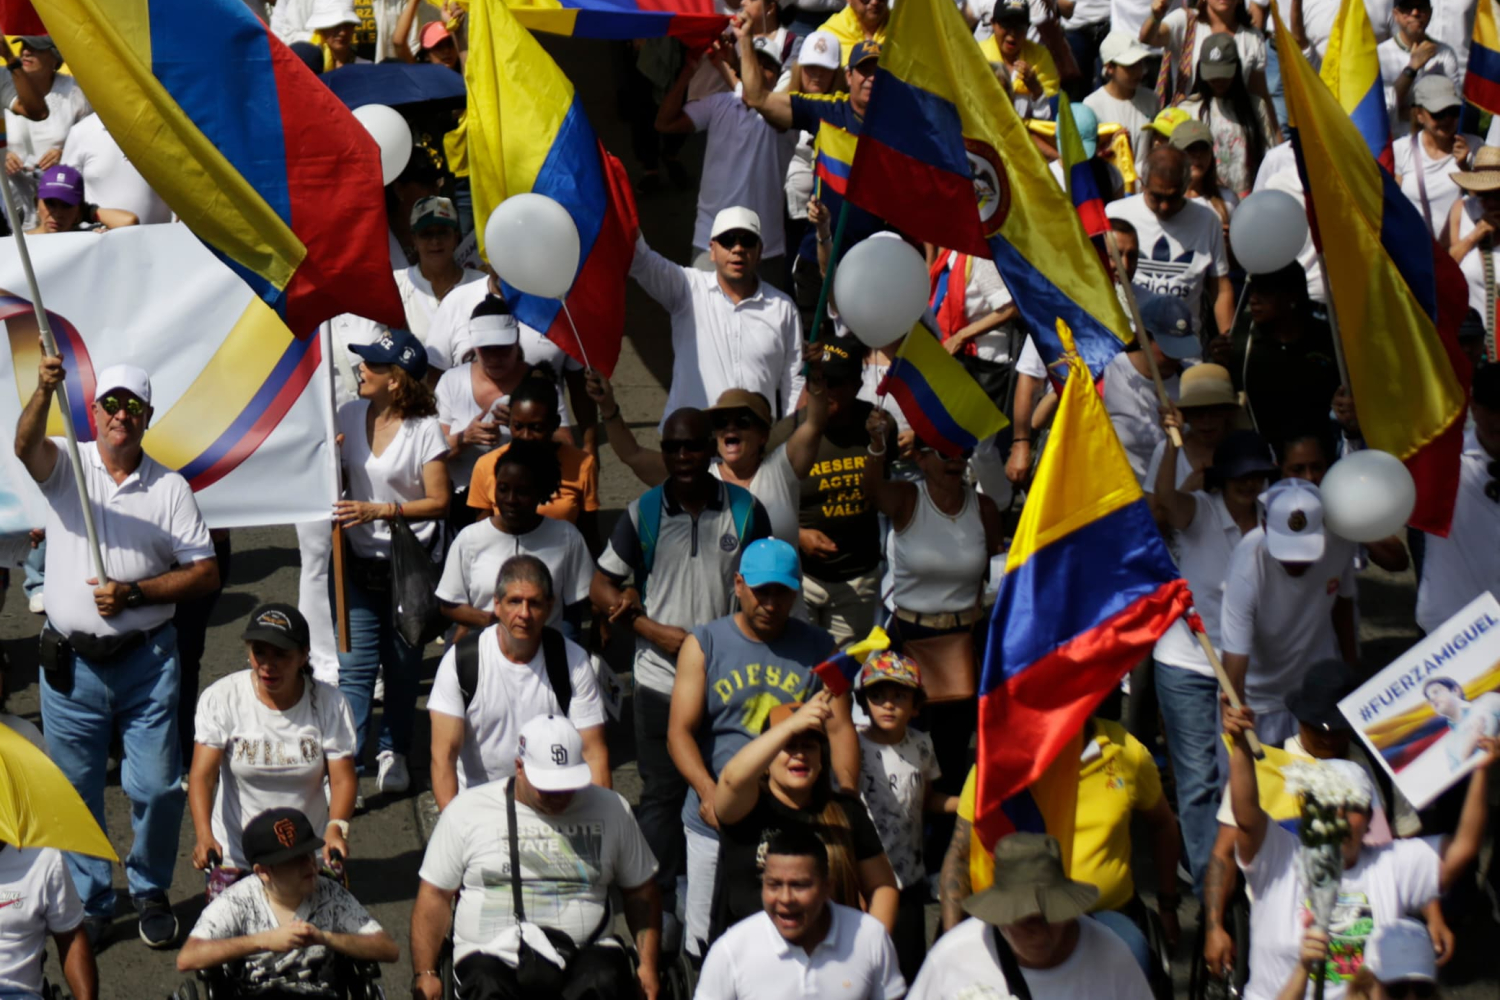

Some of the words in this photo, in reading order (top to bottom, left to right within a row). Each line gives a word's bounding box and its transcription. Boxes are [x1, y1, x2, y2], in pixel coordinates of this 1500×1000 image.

[1140, 279, 1191, 298] didas
[823, 343, 850, 360] RANO
[809, 455, 868, 477] RESER
[818, 473, 864, 492] ACTI
[821, 502, 863, 518] VALL
